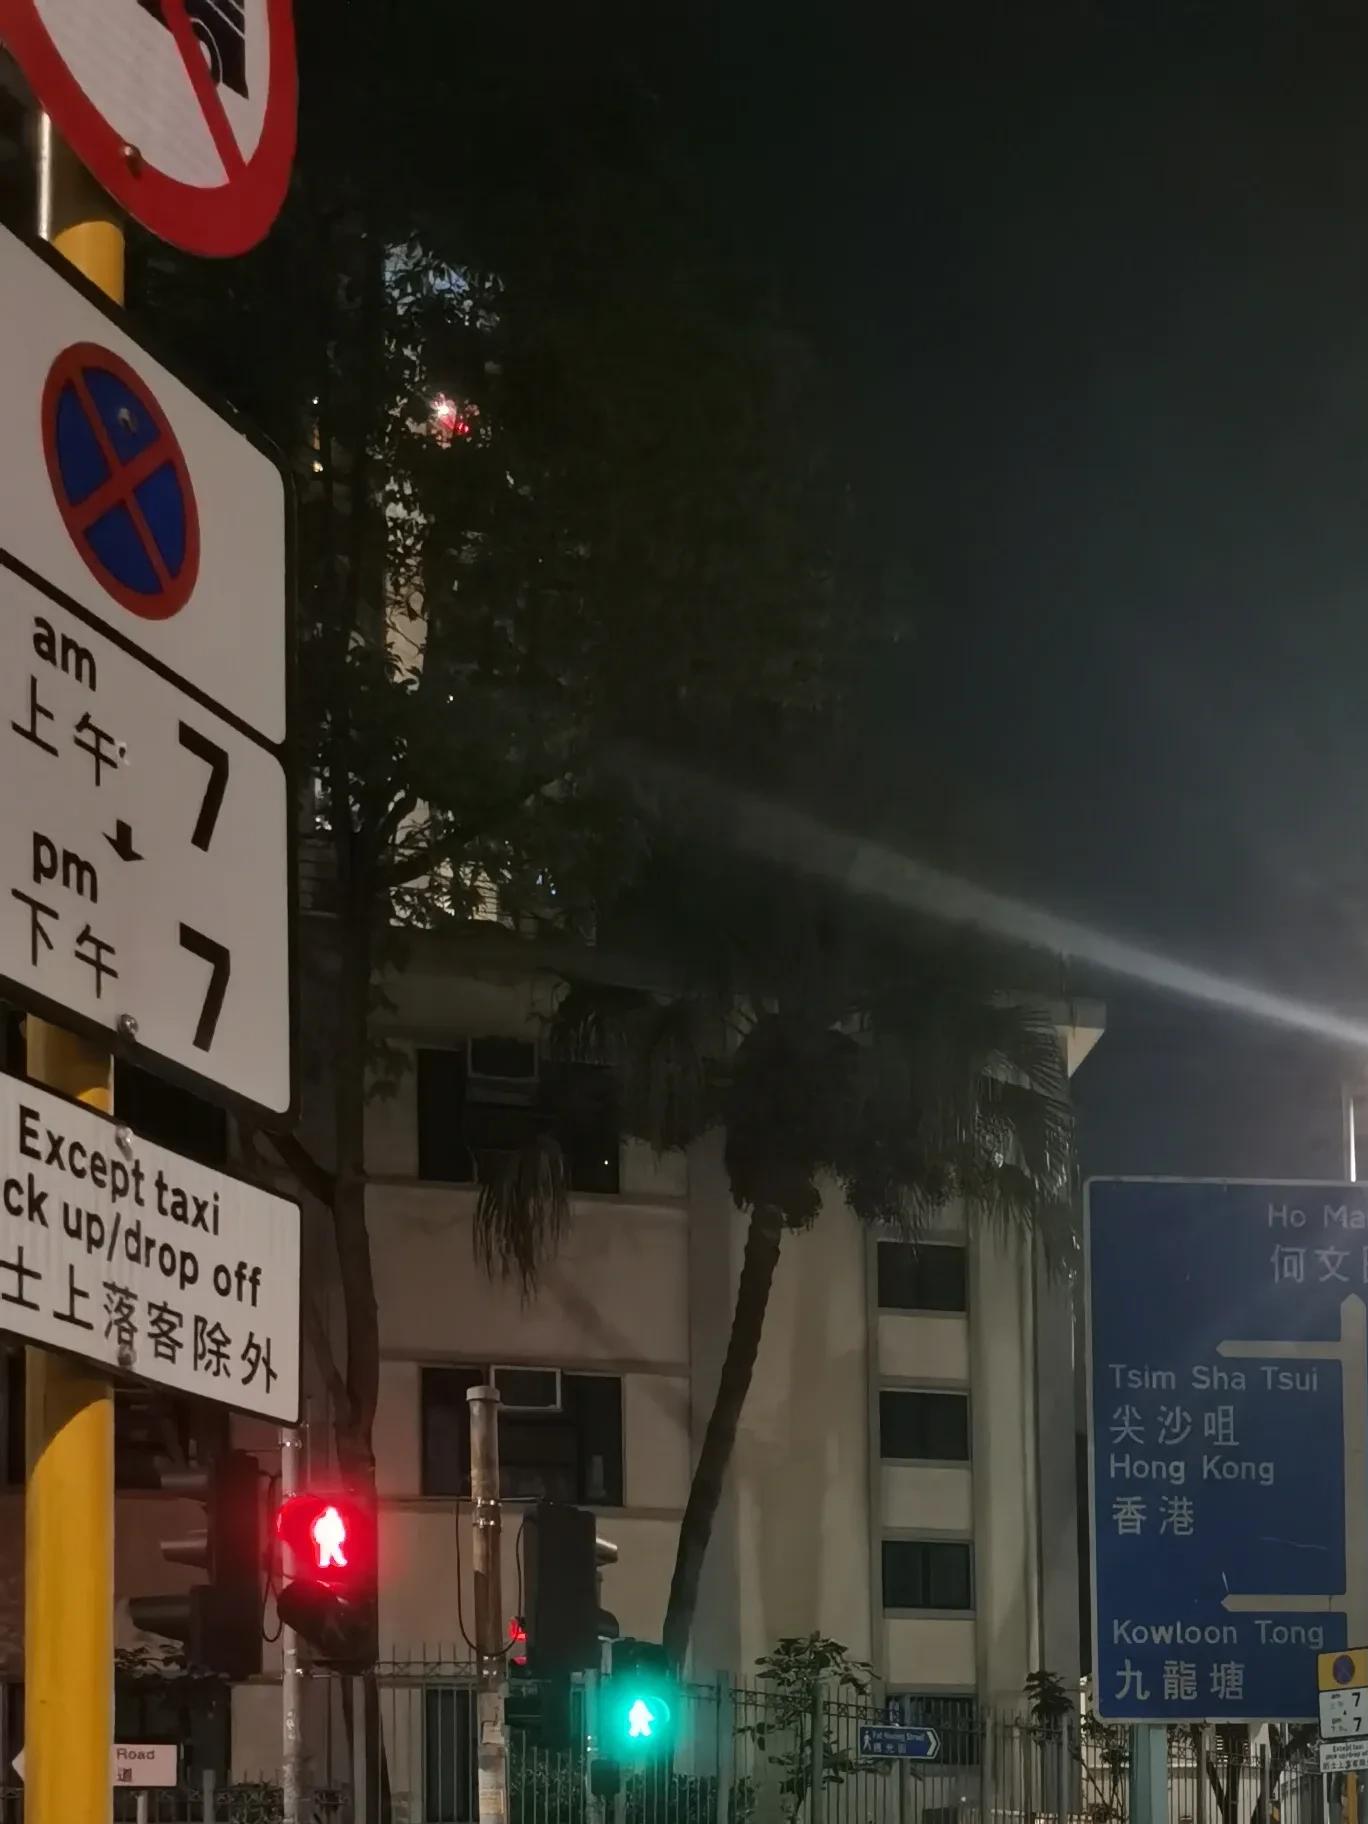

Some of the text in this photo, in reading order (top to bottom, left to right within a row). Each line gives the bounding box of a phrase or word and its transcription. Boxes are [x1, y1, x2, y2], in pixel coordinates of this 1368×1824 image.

[33, 616, 97, 691] am
[11, 674, 118, 786] 上午
[178, 719, 229, 852] 7
[33, 831, 98, 903] pm
[11, 888, 119, 999] 下午
[178, 921, 230, 1052] 7
[19, 1104, 220, 1236] Except taxi
[1267, 1204, 1306, 1228] Ho
[62, 1200, 199, 1290] up/drop
[213, 1261, 263, 1307] off
[1108, 1364, 1319, 1392] Tsim Sha Tsui
[1109, 1404, 1240, 1446] 尖沙咀
[1109, 1453, 1275, 1486] Hong Kong
[1112, 1496, 1195, 1536] 香港
[1112, 1619, 1324, 1650] Kowloon Tong
[1114, 1658, 1246, 1701] 九龍塘
[1352, 1692, 1361, 1707] 7
[1353, 1717, 1362, 1732] 7
[116, 1747, 156, 1761] Road
